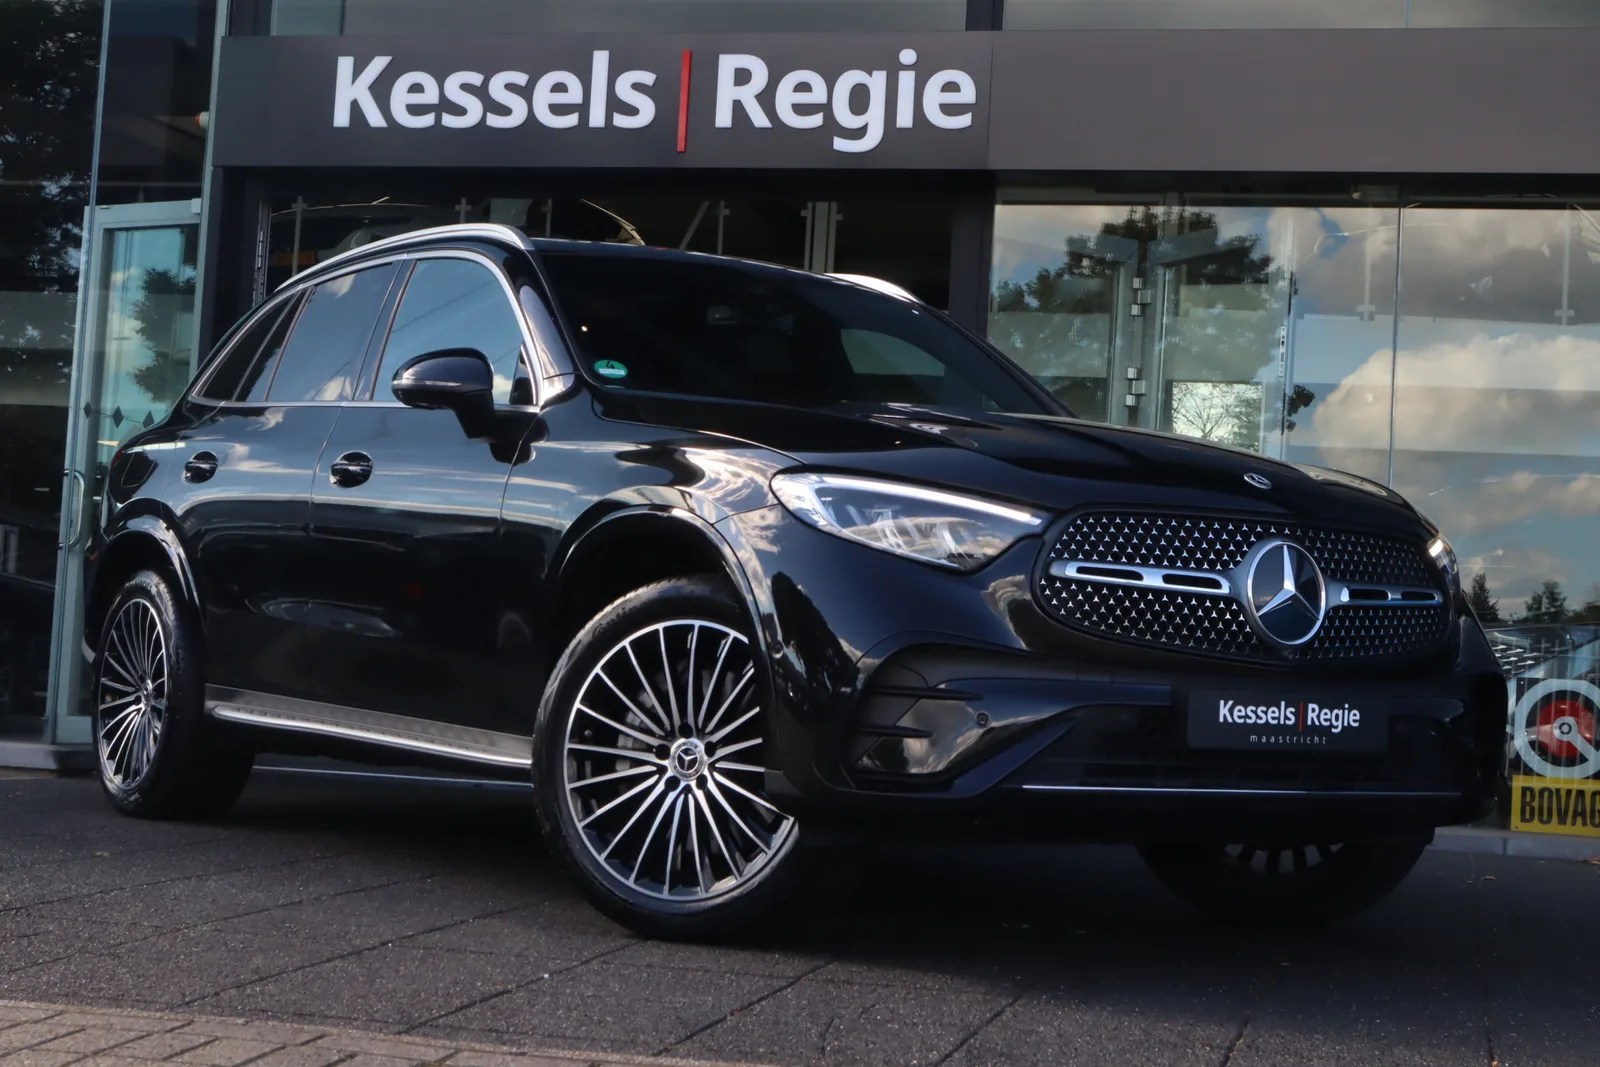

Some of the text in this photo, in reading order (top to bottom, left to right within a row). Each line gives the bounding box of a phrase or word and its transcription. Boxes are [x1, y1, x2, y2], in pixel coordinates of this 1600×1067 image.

[333, 48, 977, 153] Kessels Regie
[1218, 699, 1361, 733] Kessels Regie
[1250, 733, 1327, 745] maastricht
[1520, 786, 1600, 828] BOVAG
